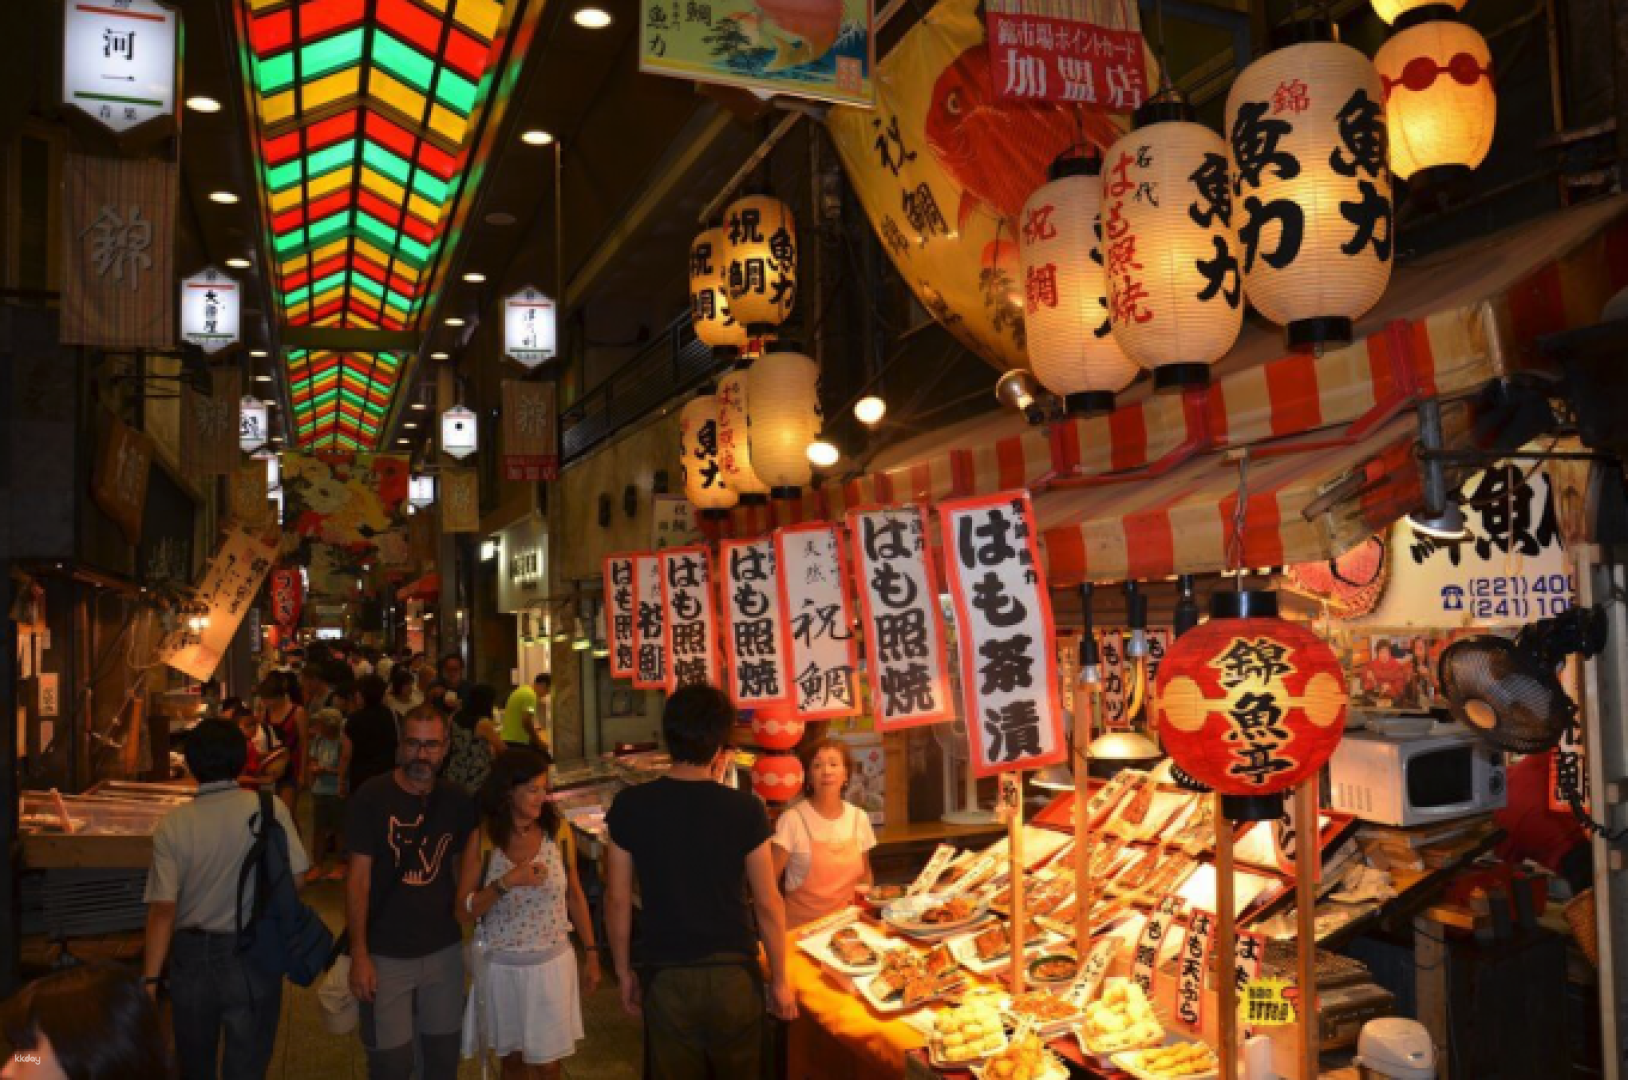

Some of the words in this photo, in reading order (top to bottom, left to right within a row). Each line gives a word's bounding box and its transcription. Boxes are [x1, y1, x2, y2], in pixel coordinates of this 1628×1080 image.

[102, 28, 136, 81] 河一
[1000, 49, 1142, 110] 加盟店
[1272, 79, 1310, 114] 錦
[1134, 145, 1159, 208] 名代
[1187, 153, 1242, 309] 魚力
[1233, 102, 1304, 272] 魚力
[1329, 89, 1391, 262] 魚力
[729, 209, 764, 299] 祝鯛
[1024, 204, 1059, 315] 祝鯛
[730, 546, 779, 698] はも照焼
[792, 598, 855, 711] 祝鯛
[864, 516, 934, 718] はも照焼
[958, 508, 1042, 763] はも茶漬
[1212, 638, 1294, 785] 錦魚亭
